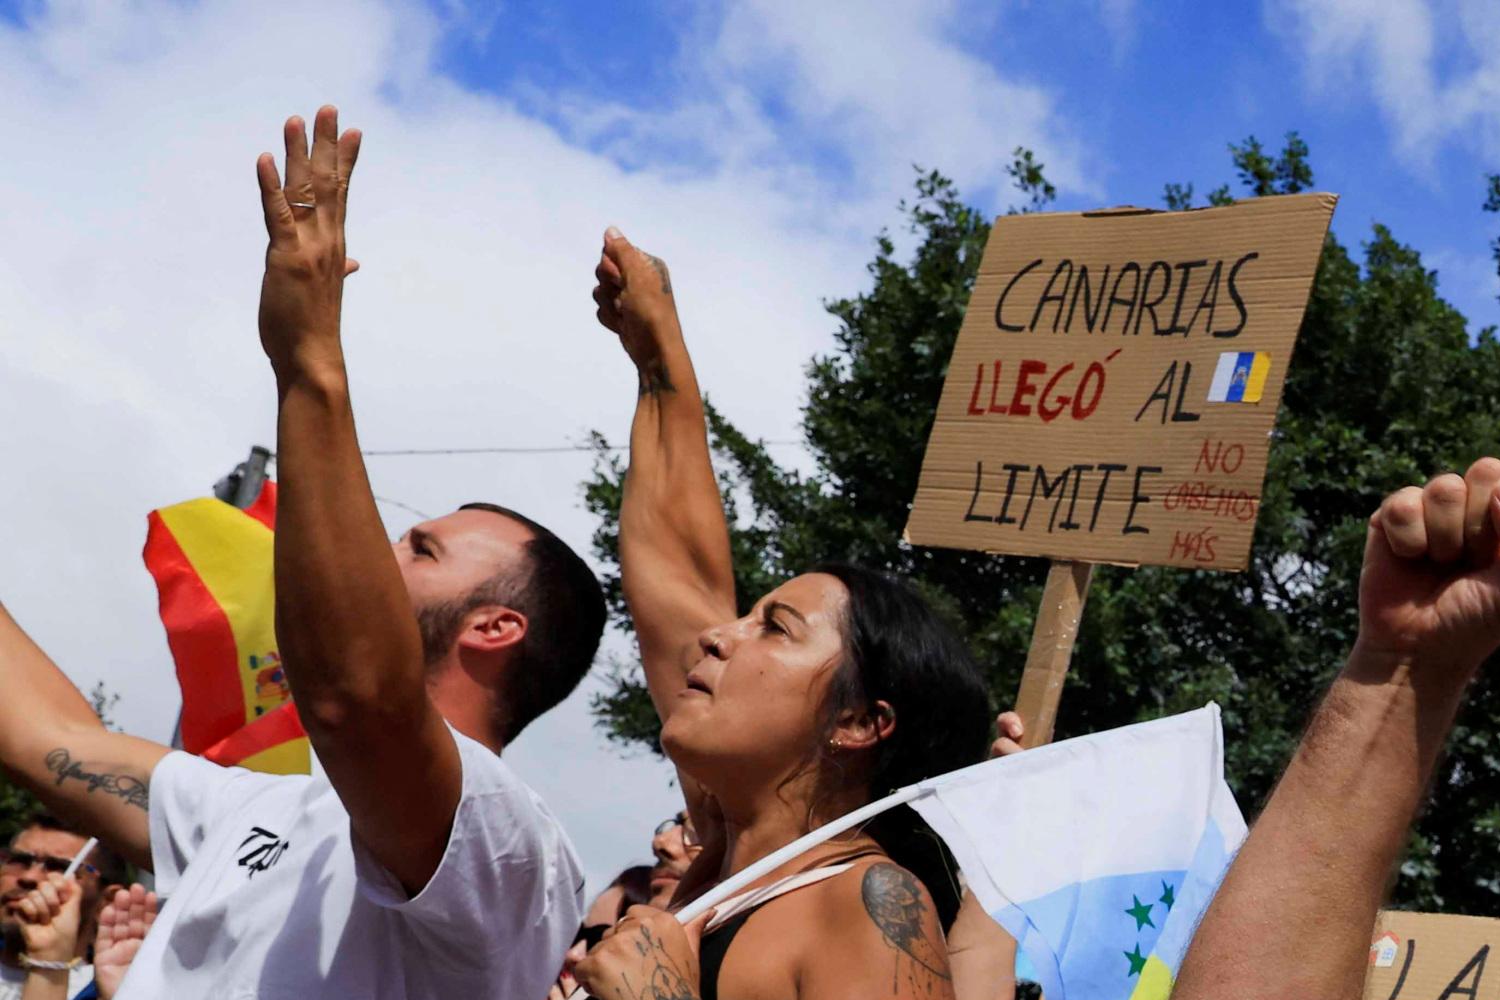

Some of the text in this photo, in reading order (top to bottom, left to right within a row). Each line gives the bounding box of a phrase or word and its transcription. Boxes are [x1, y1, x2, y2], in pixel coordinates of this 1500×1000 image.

[994, 252, 1260, 339] CANARIAS
[966, 348, 1200, 425] LLEGÓ AL
[1194, 439, 1246, 475] NO
[964, 461, 1163, 536] LIMITE
